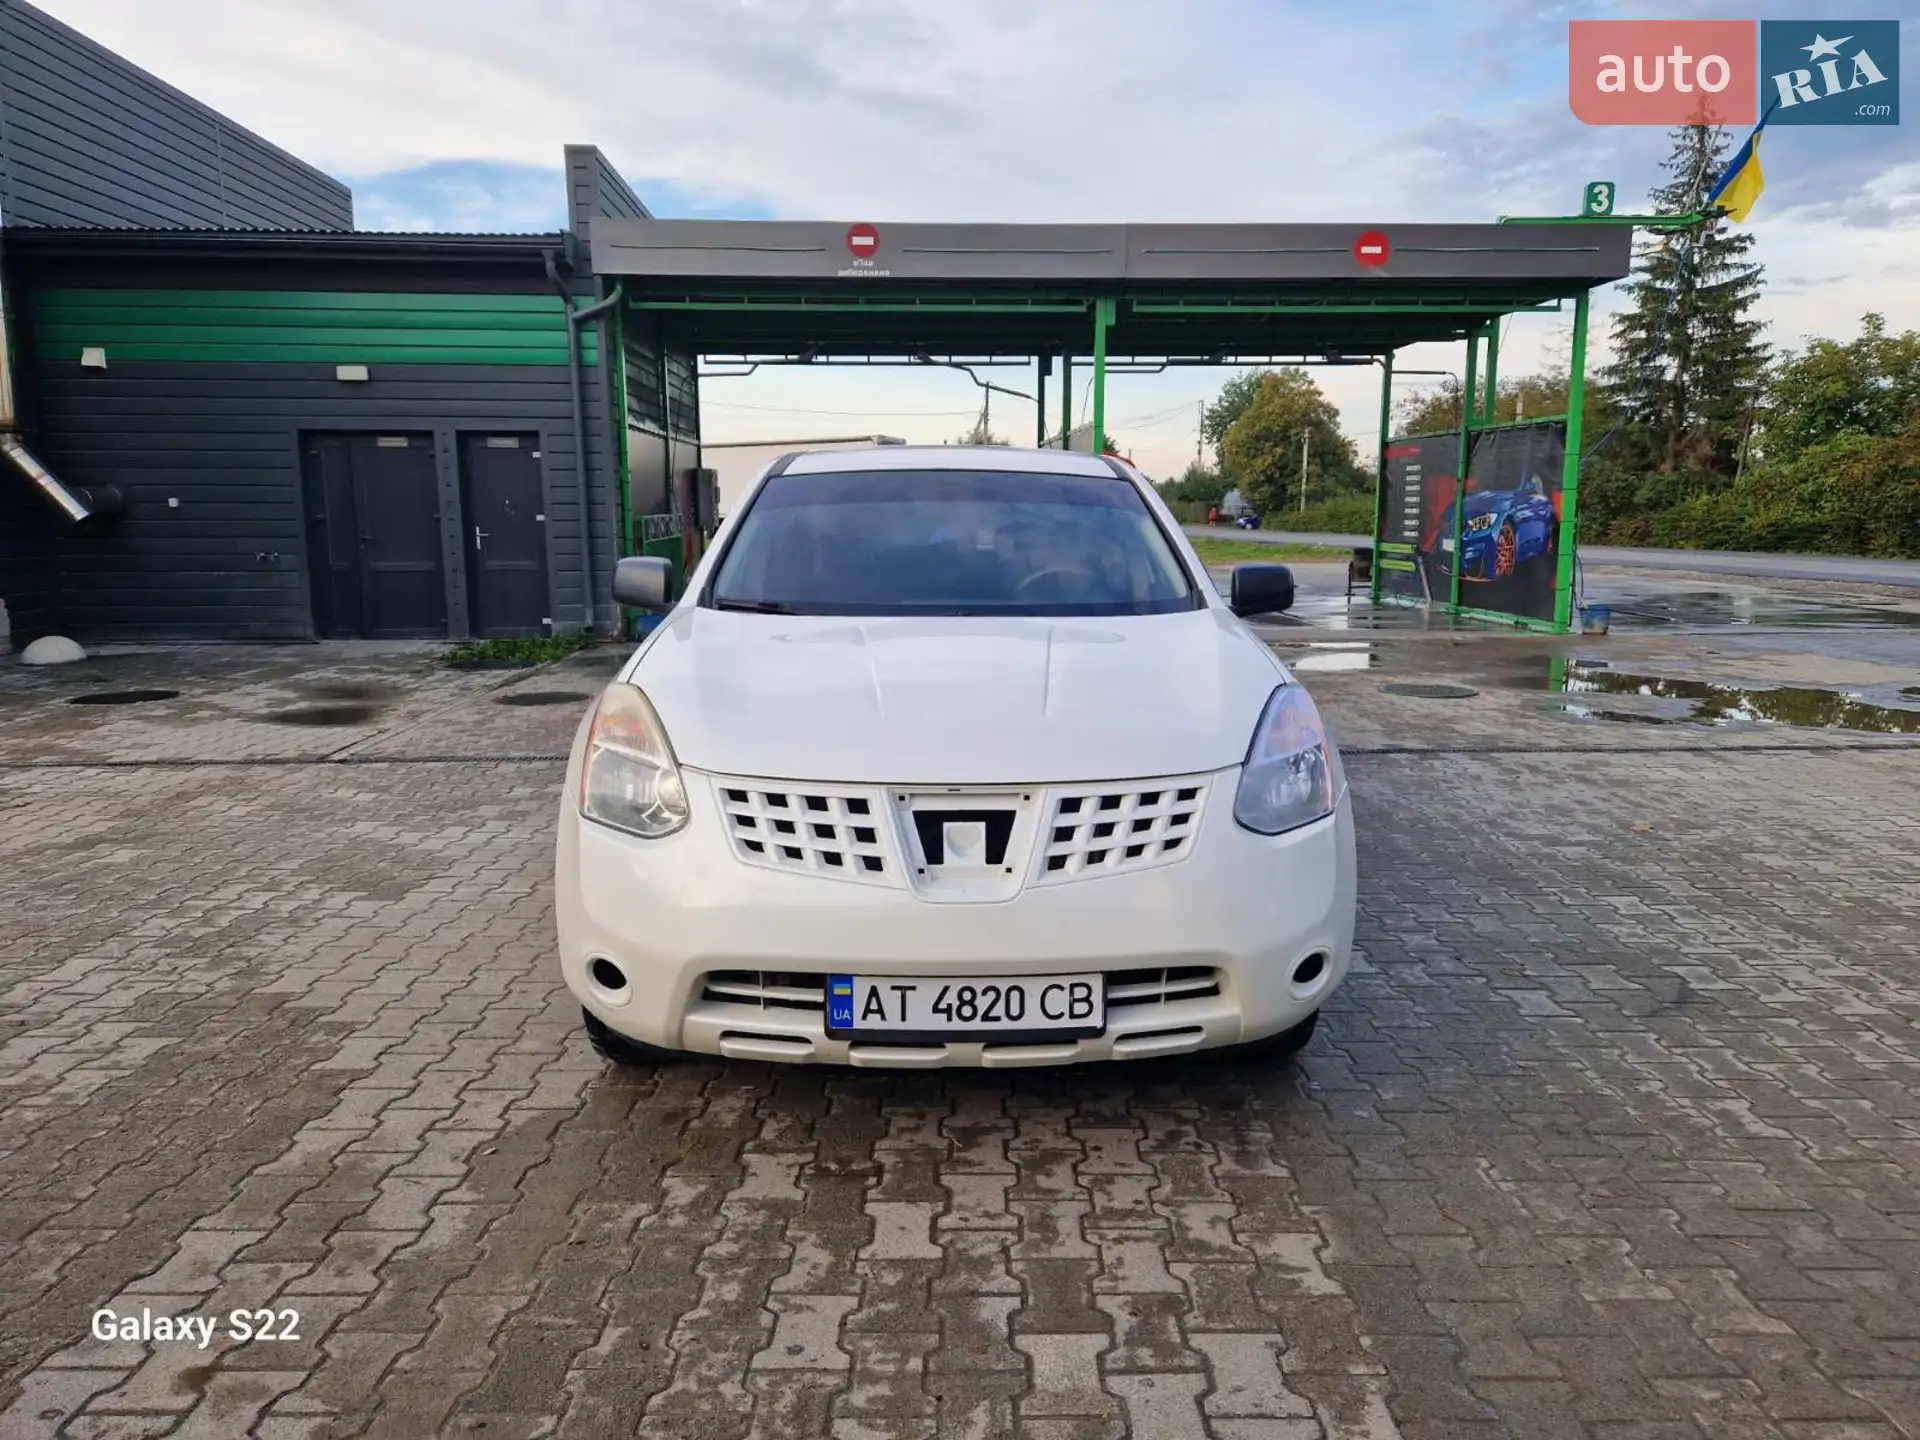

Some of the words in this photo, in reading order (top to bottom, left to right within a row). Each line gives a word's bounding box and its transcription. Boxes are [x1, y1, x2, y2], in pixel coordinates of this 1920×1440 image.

[1590, 184, 1609, 213] 3
[833, 1008, 851, 1021] UA
[861, 984, 917, 1022] AT
[931, 984, 1026, 1023] 4820
[1039, 982, 1095, 1020] CB
